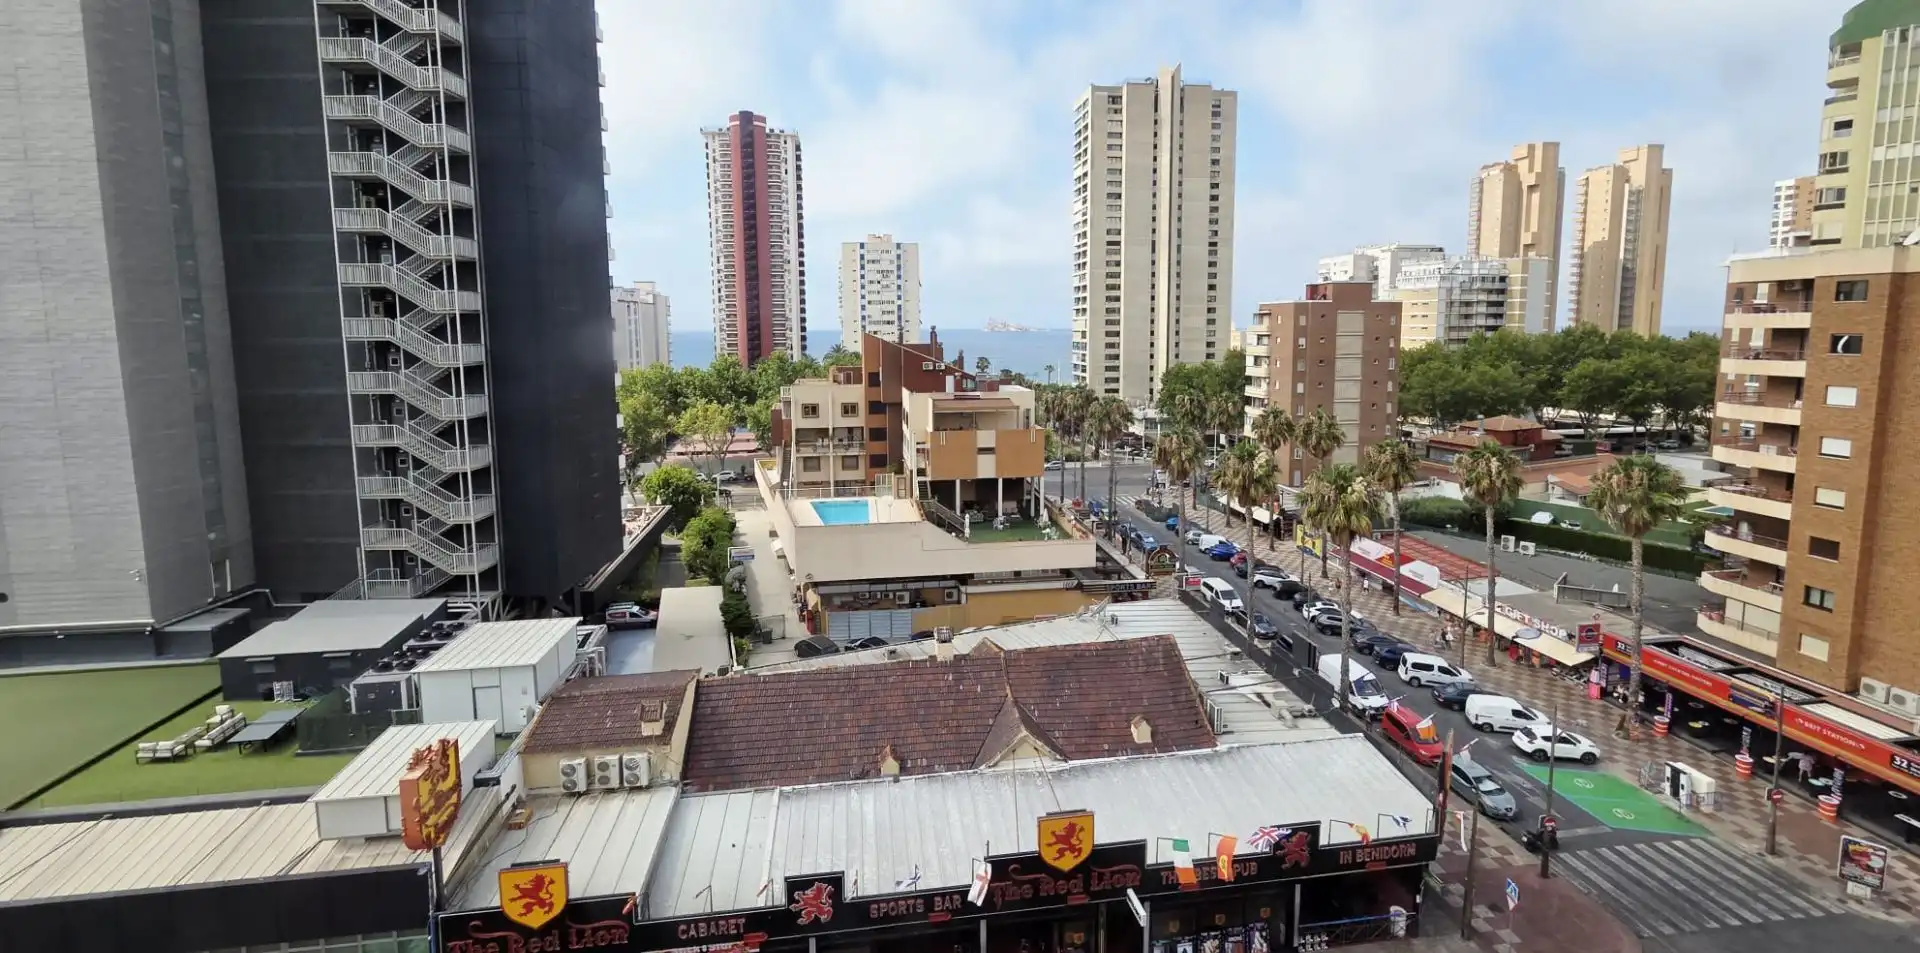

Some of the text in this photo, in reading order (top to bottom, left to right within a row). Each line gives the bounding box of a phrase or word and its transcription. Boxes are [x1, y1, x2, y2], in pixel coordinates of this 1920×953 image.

[1505, 606, 1531, 623] GIFT
[1534, 616, 1568, 638] SHOP
[1893, 755, 1908, 769] 32
[1340, 850, 1353, 865] IN
[1160, 861, 1258, 885] TH BES PUB
[989, 868, 1141, 911] The Red Lion
[869, 894, 961, 919] SPORTS BAR
[506, 929, 562, 953] Red
[568, 924, 629, 950] Lion
[677, 917, 746, 940] CABARET
